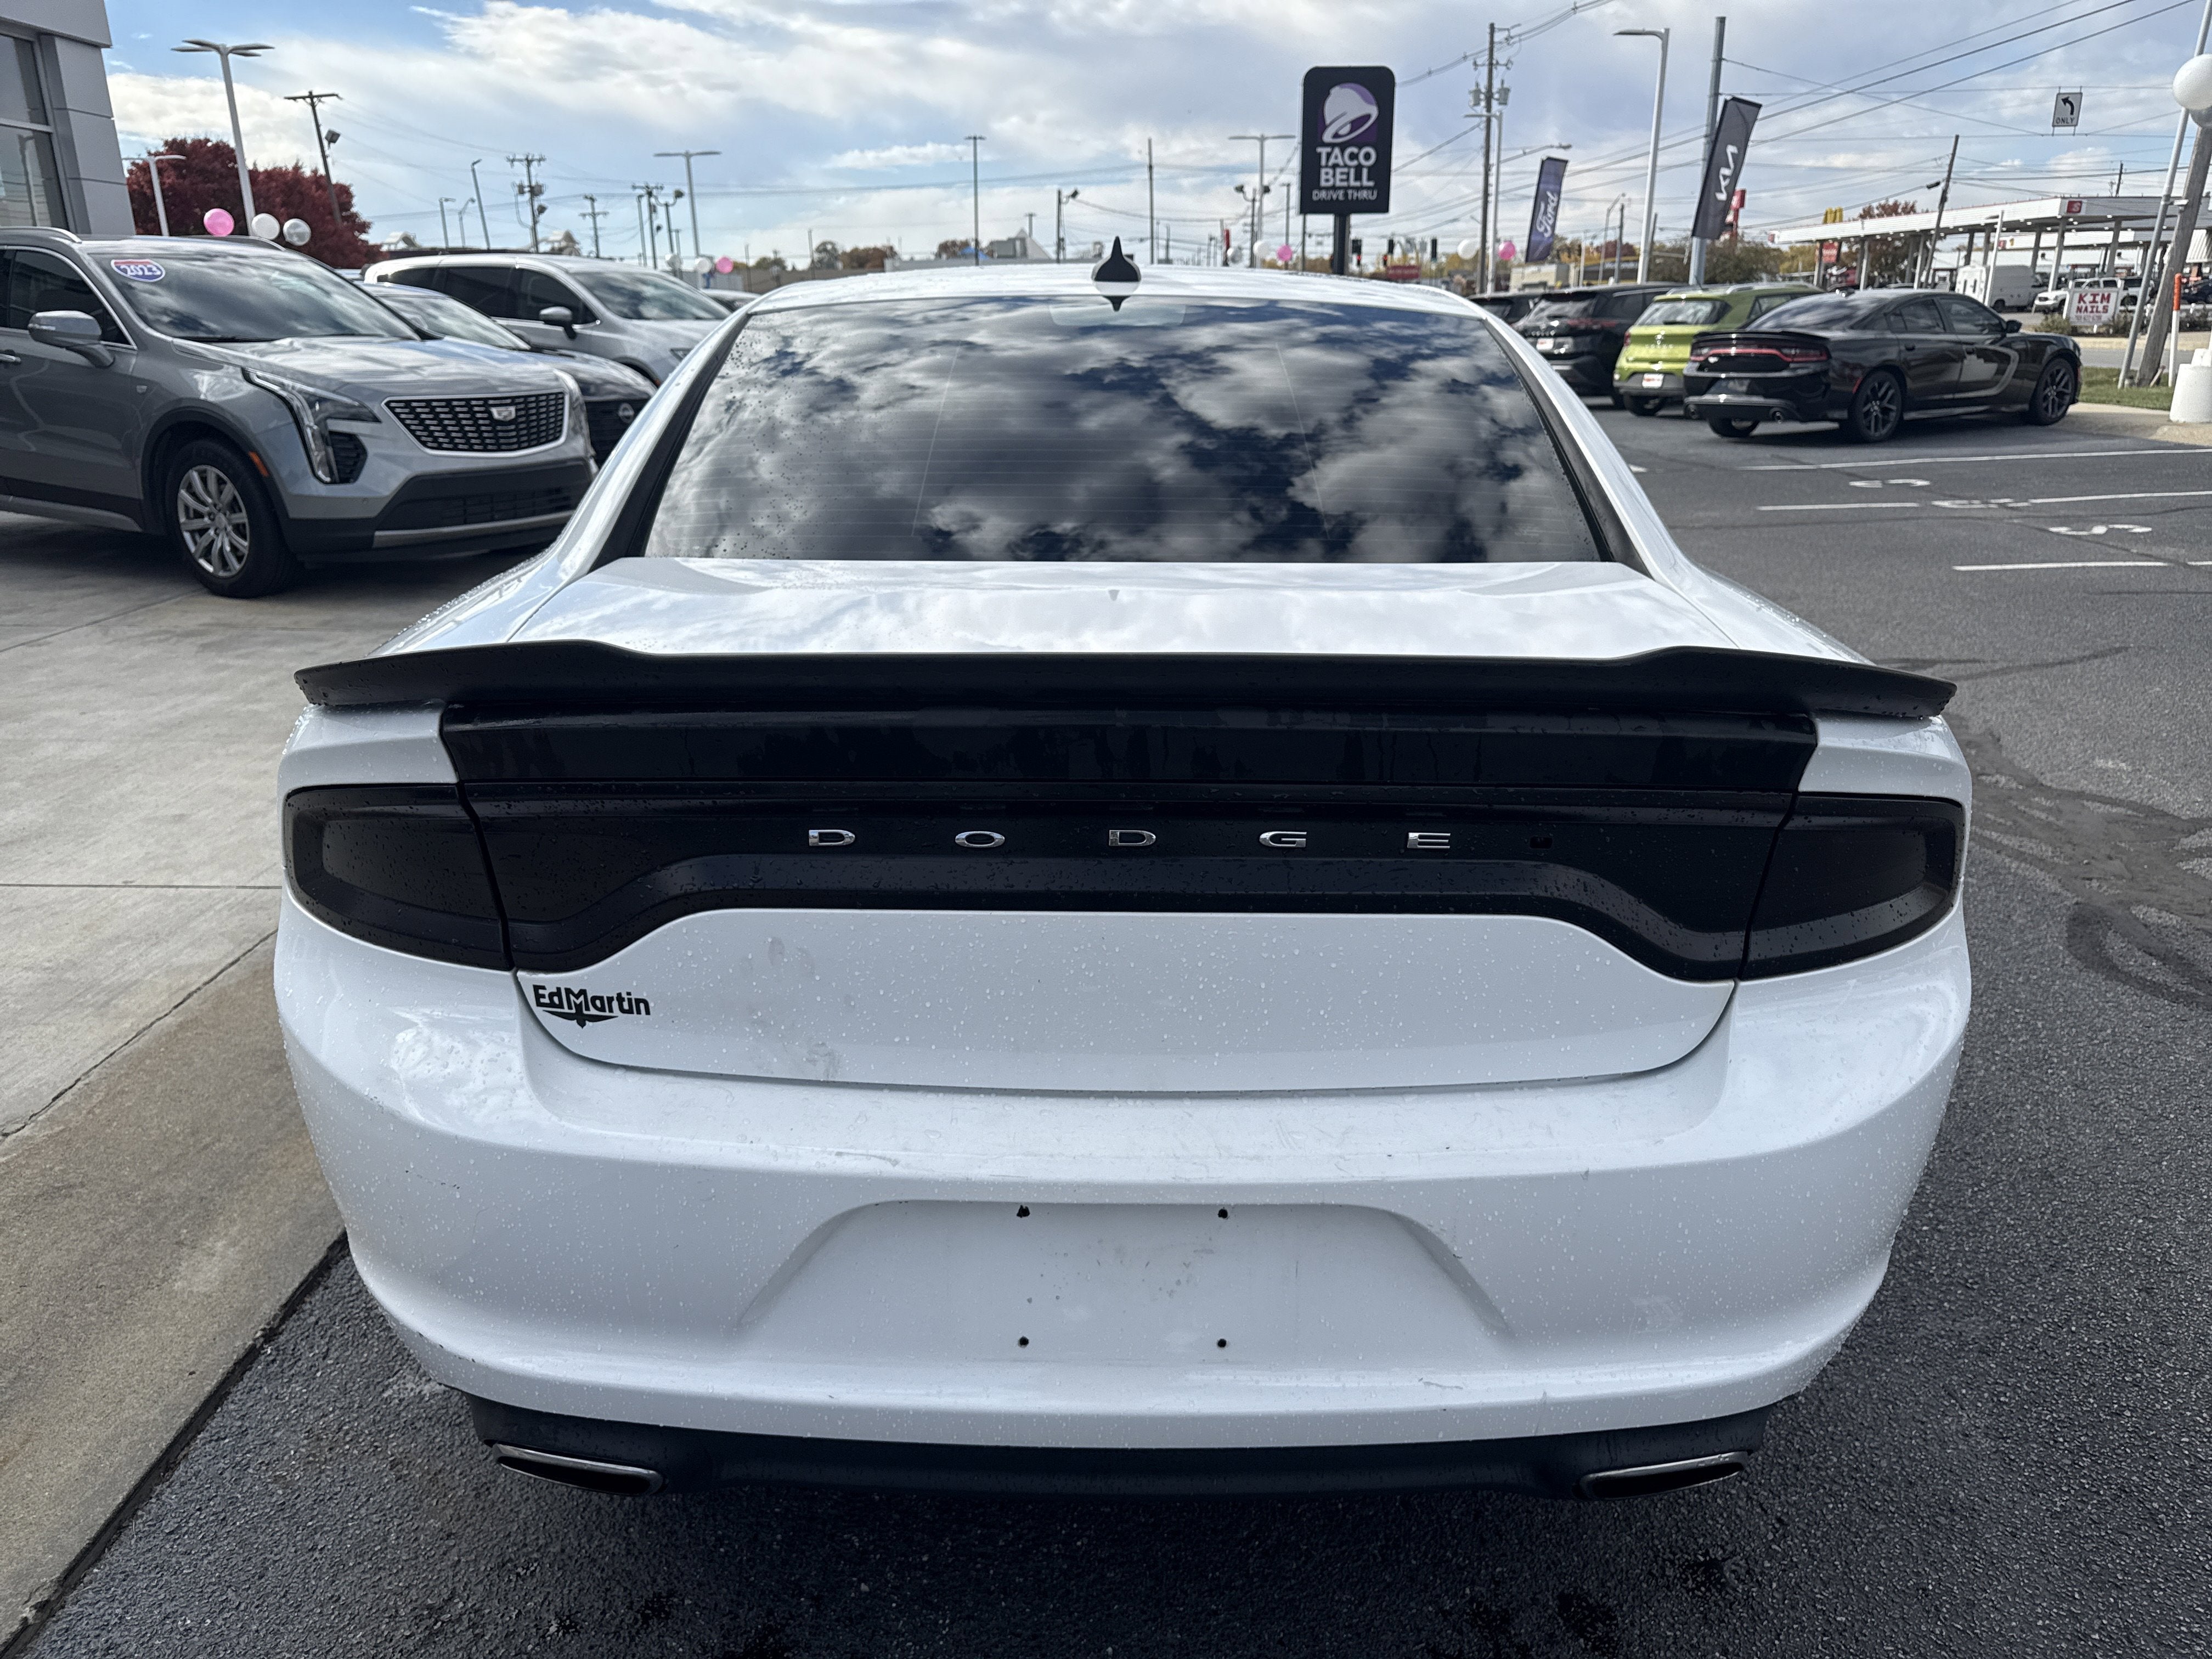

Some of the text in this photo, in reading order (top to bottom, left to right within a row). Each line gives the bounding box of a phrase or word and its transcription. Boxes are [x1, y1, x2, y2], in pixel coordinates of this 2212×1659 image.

[1316, 146, 1377, 166] TACO
[1319, 167, 1375, 187] BELL
[1312, 189, 1378, 201] DRIVE THRU
[1537, 190, 1559, 238] Ford
[120, 264, 161, 276] 2023
[2078, 292, 2111, 304] KIM
[2075, 305, 2109, 314] NAILS
[809, 829, 1451, 849] DODGE
